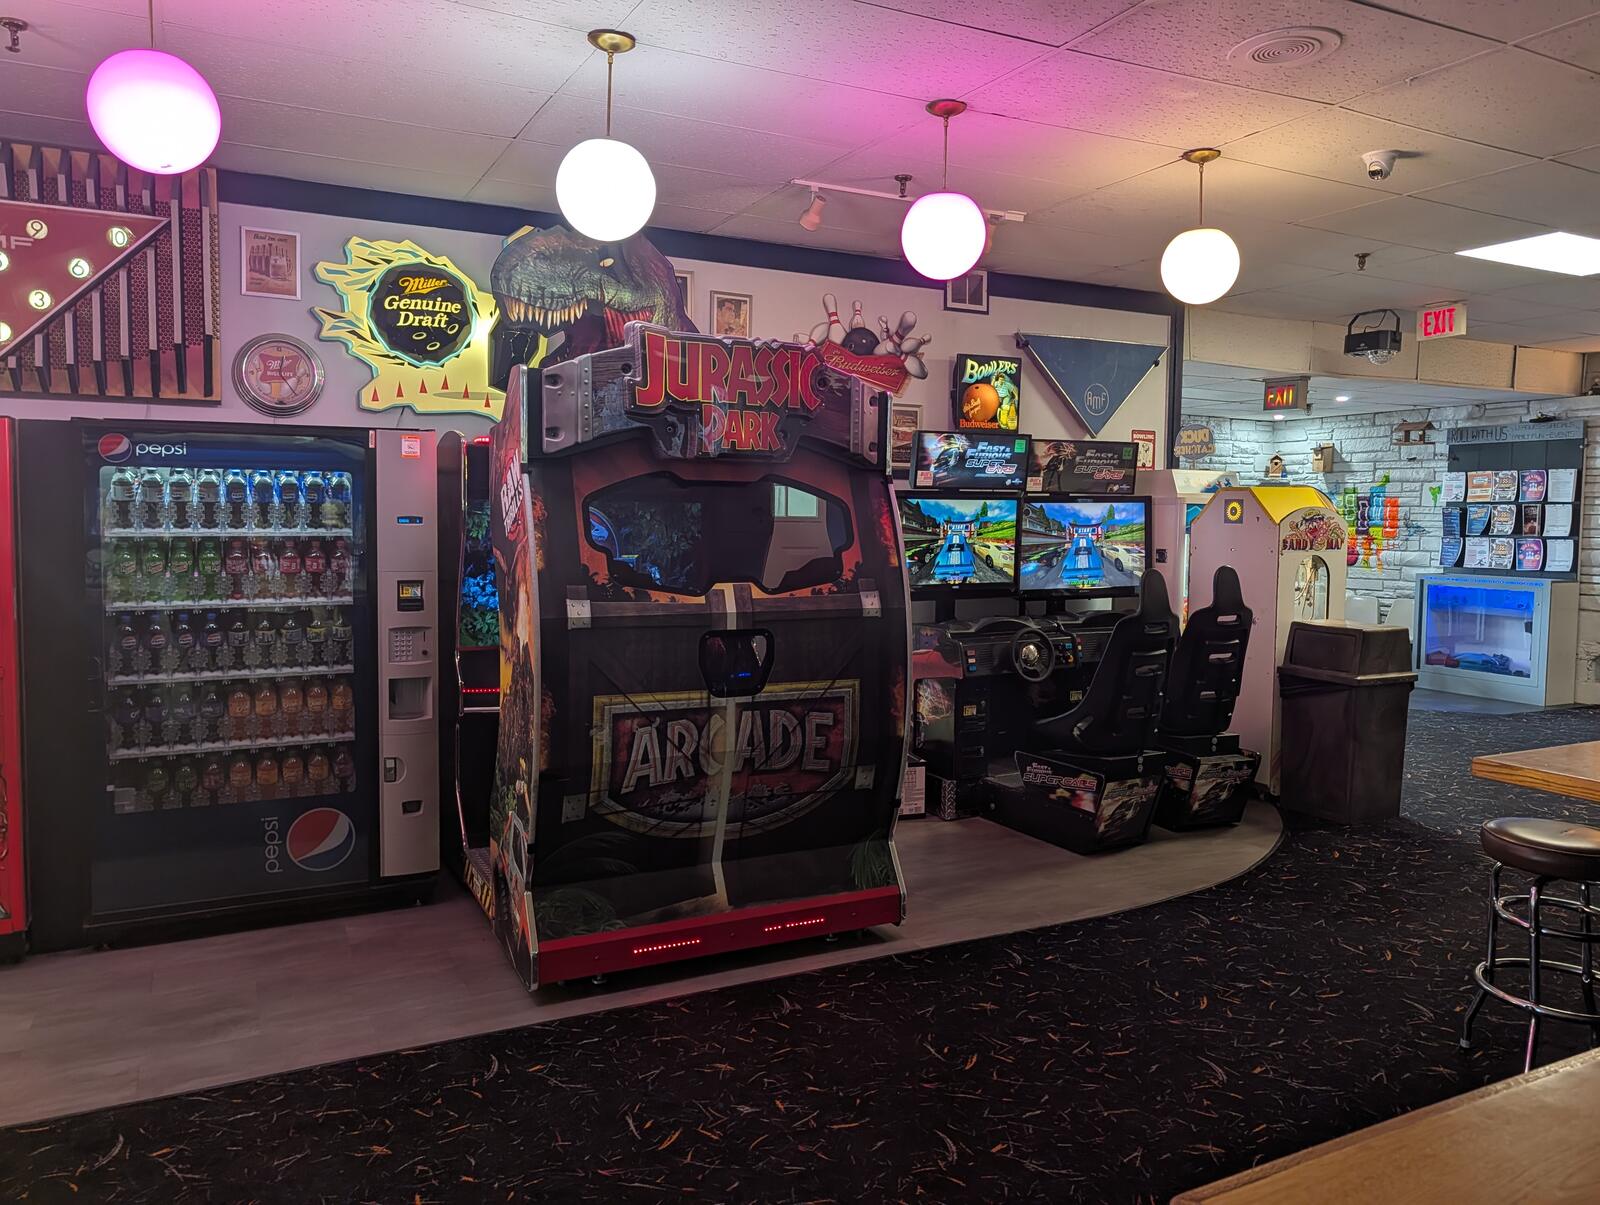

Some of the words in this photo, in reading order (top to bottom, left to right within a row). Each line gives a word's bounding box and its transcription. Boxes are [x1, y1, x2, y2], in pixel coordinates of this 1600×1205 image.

[30, 221, 44, 238] 9
[71, 260, 84, 276] 6
[399, 277, 449, 295] Miller
[34, 291, 45, 308] 3
[384, 295, 462, 314] Genuine
[396, 311, 449, 329] Draft
[1423, 306, 1457, 337] EXIT
[636, 331, 825, 411] JURASSIC
[824, 354, 900, 377] Budweiser
[961, 358, 1019, 384] BOWLERS
[1267, 385, 1294, 409] EXIT
[702, 404, 782, 453] PARK
[959, 418, 1000, 429] Budweiser
[1495, 425, 1508, 441] US
[135, 442, 187, 457] pepsi
[965, 458, 1005, 467] SUPER
[620, 709, 835, 795] ARCADE
[260, 816, 284, 873] pepsi
